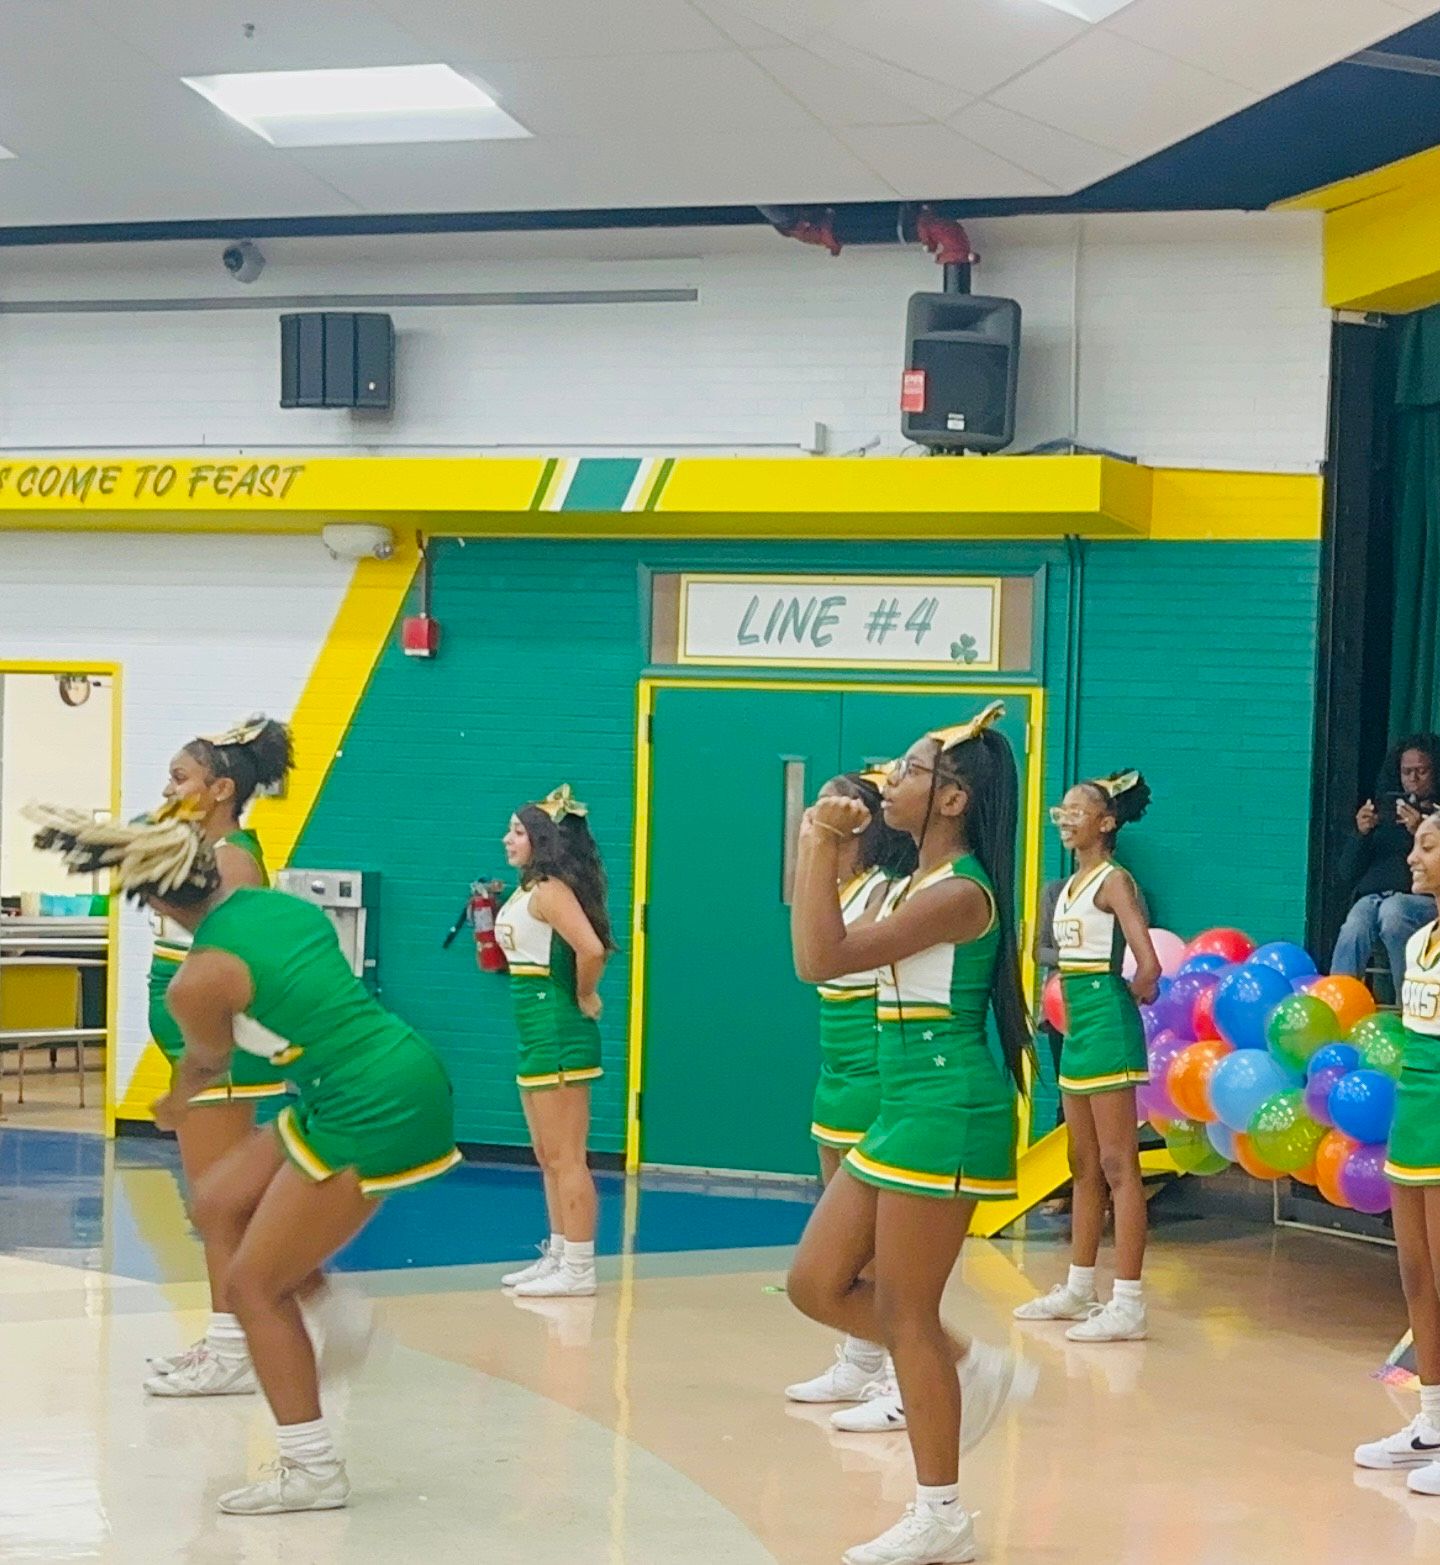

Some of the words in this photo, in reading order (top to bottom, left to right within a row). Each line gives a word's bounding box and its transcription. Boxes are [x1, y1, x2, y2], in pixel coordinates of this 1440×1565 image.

[16, 465, 122, 503] COME
[134, 465, 177, 498] TO
[188, 464, 305, 499] FEAST
[737, 595, 847, 648] LINE
[863, 597, 939, 646] #4
